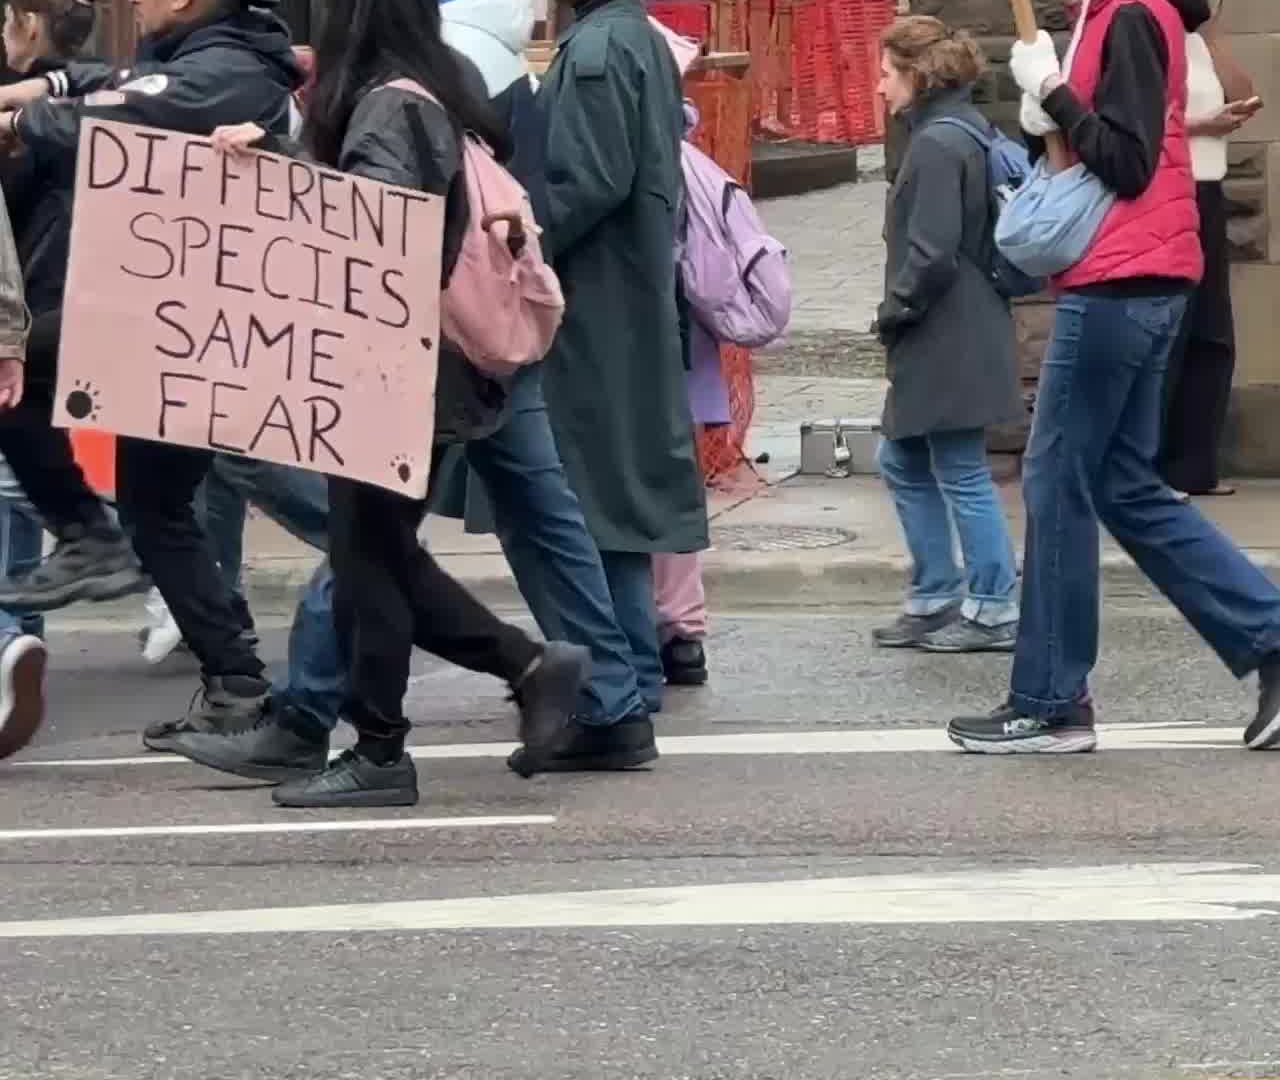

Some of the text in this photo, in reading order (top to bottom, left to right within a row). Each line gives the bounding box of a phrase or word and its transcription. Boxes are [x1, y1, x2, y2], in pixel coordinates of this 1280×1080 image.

[88, 126, 430, 257] DIFFERENT
[120, 211, 410, 328] SPECIES
[155, 300, 345, 389] SAME
[158, 372, 345, 466] FEAR
